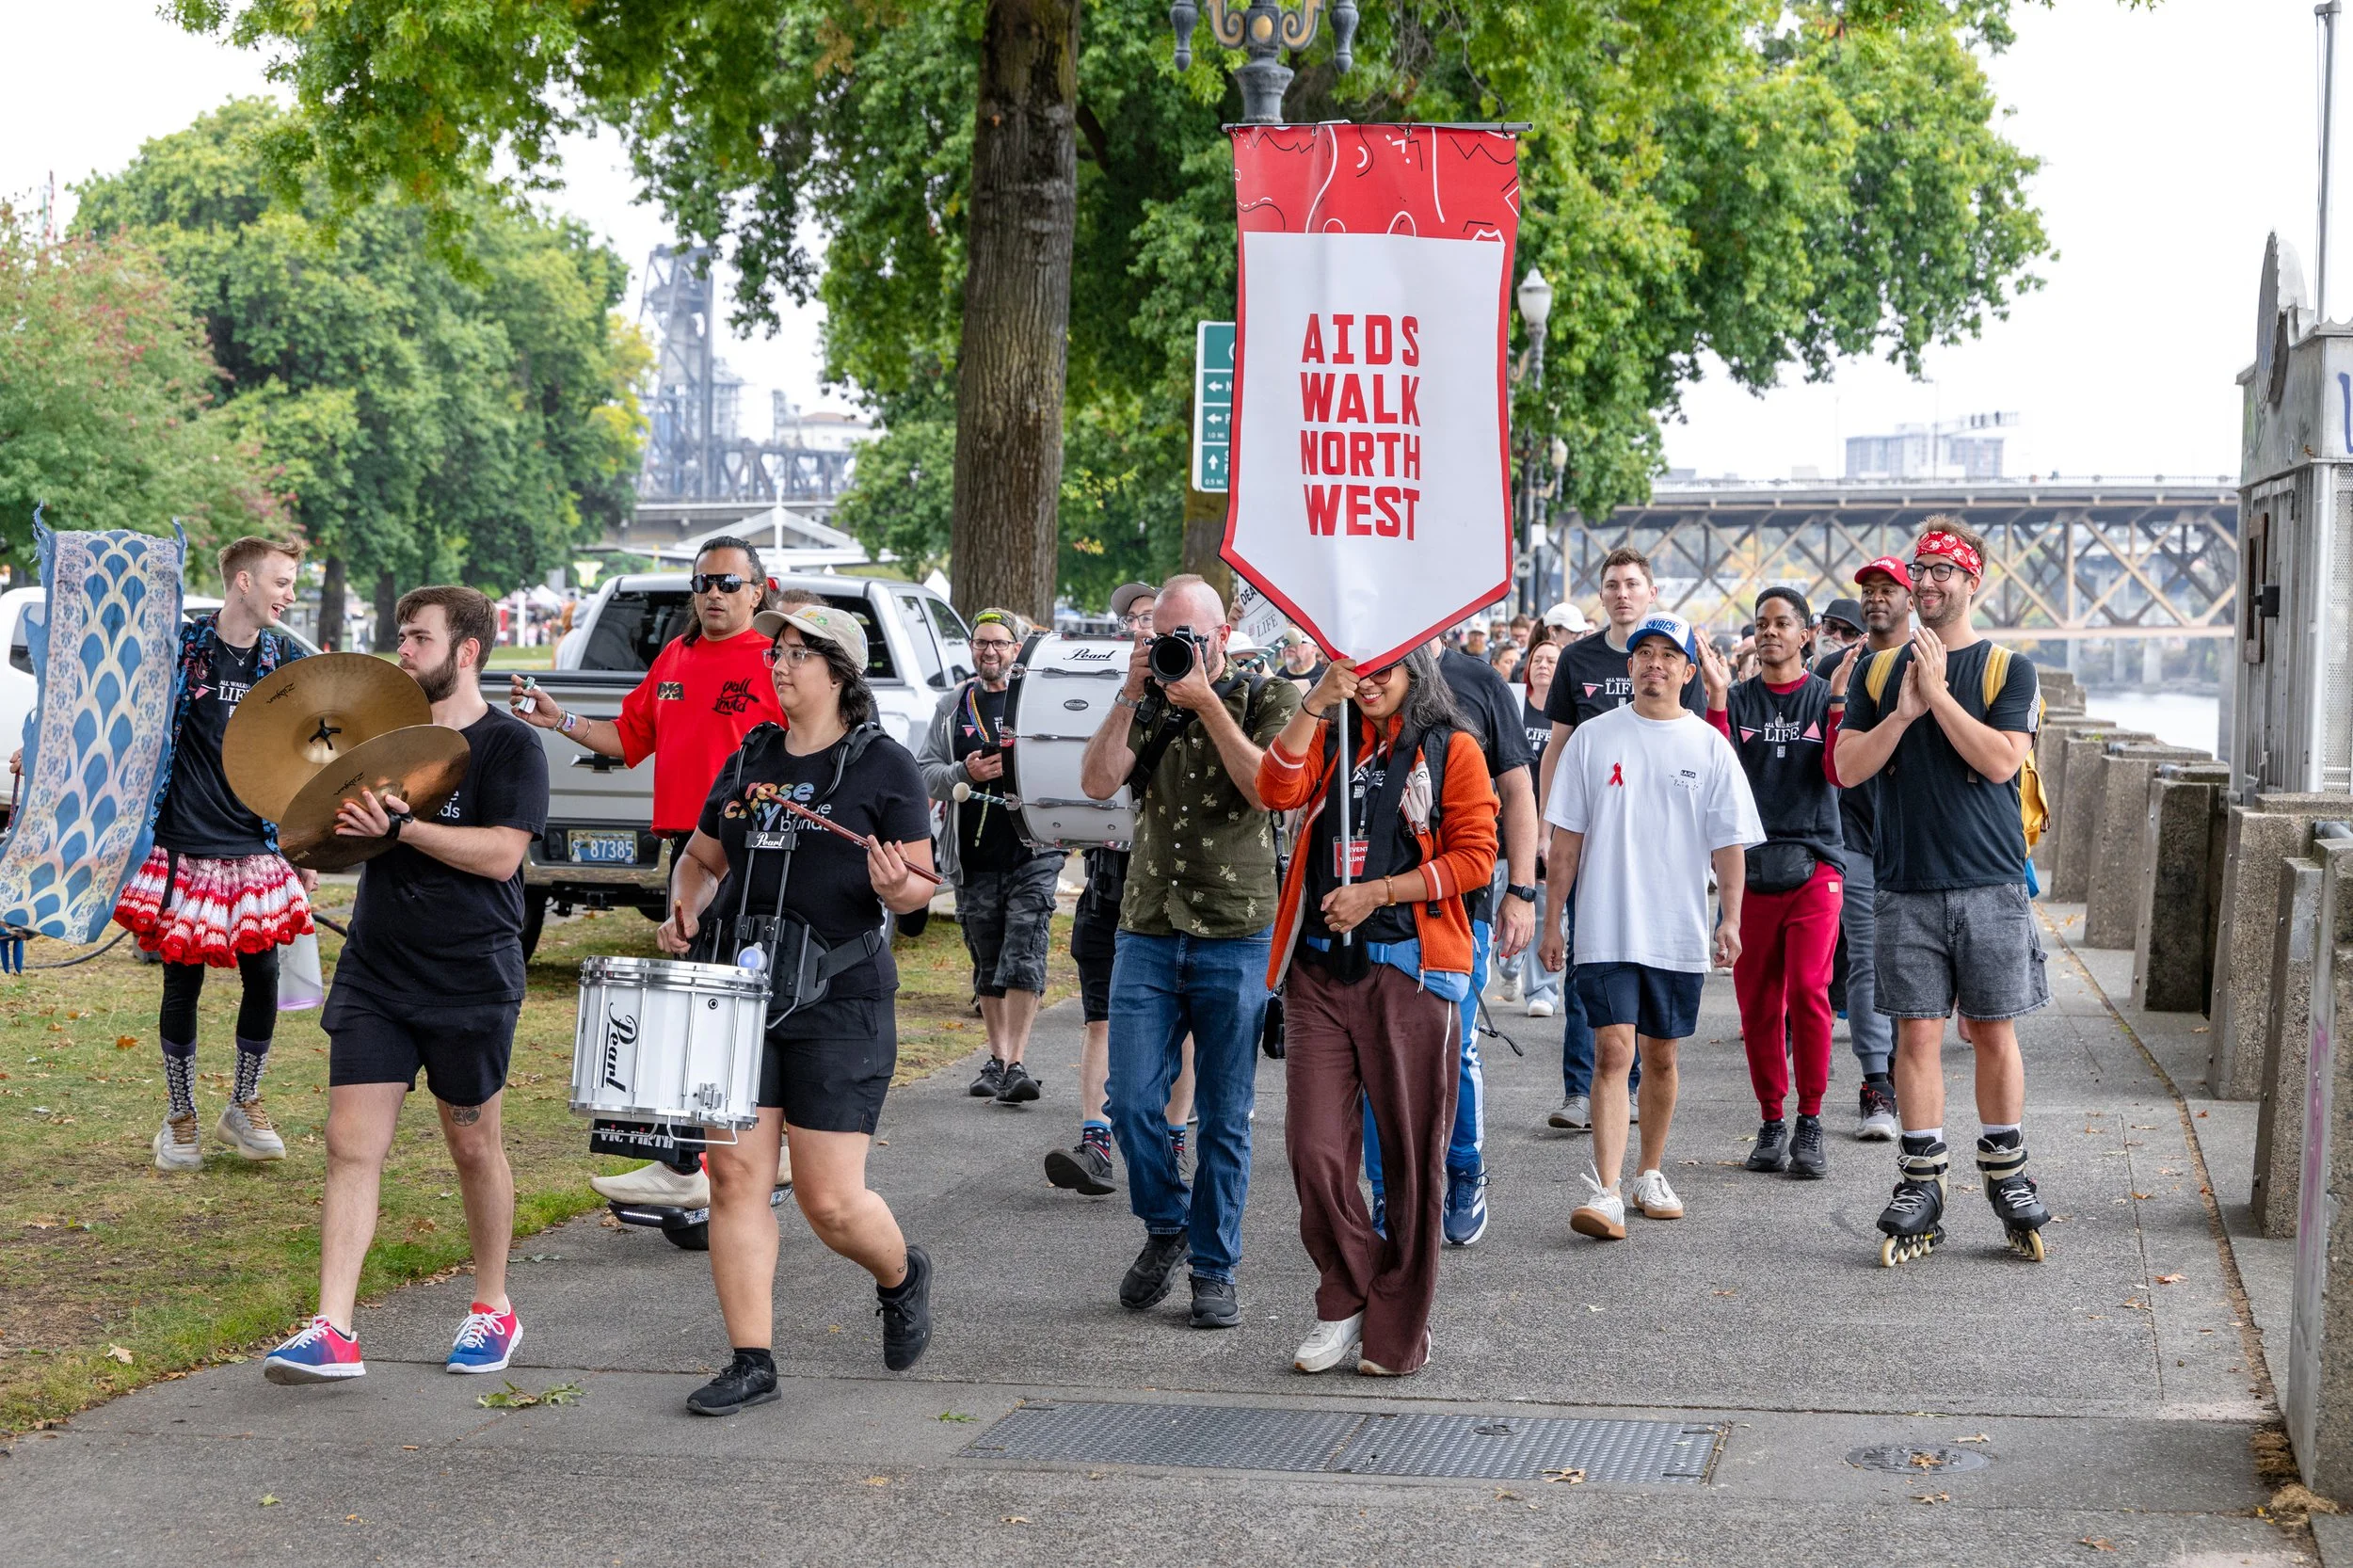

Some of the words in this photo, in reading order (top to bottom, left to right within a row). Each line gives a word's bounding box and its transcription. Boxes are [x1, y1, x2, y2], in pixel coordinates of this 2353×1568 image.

[1302, 313, 1419, 367] AIDS
[1300, 372, 1420, 426] WALK
[1301, 430, 1420, 481] NORTH
[1304, 484, 1420, 541] WEST
[1240, 585, 1259, 606] DEA
[1257, 614, 1279, 637] LIFE
[1063, 648, 1116, 661] Pearl
[217, 686, 249, 703] LIF
[1764, 727, 1800, 743] LIFE
[744, 782, 814, 801] rose
[590, 840, 633, 858] 87385
[751, 832, 785, 849] Pearl
[602, 1002, 638, 1094] Pearl
[600, 1127, 624, 1143] VIC
[629, 1128, 674, 1149] FIRTH
